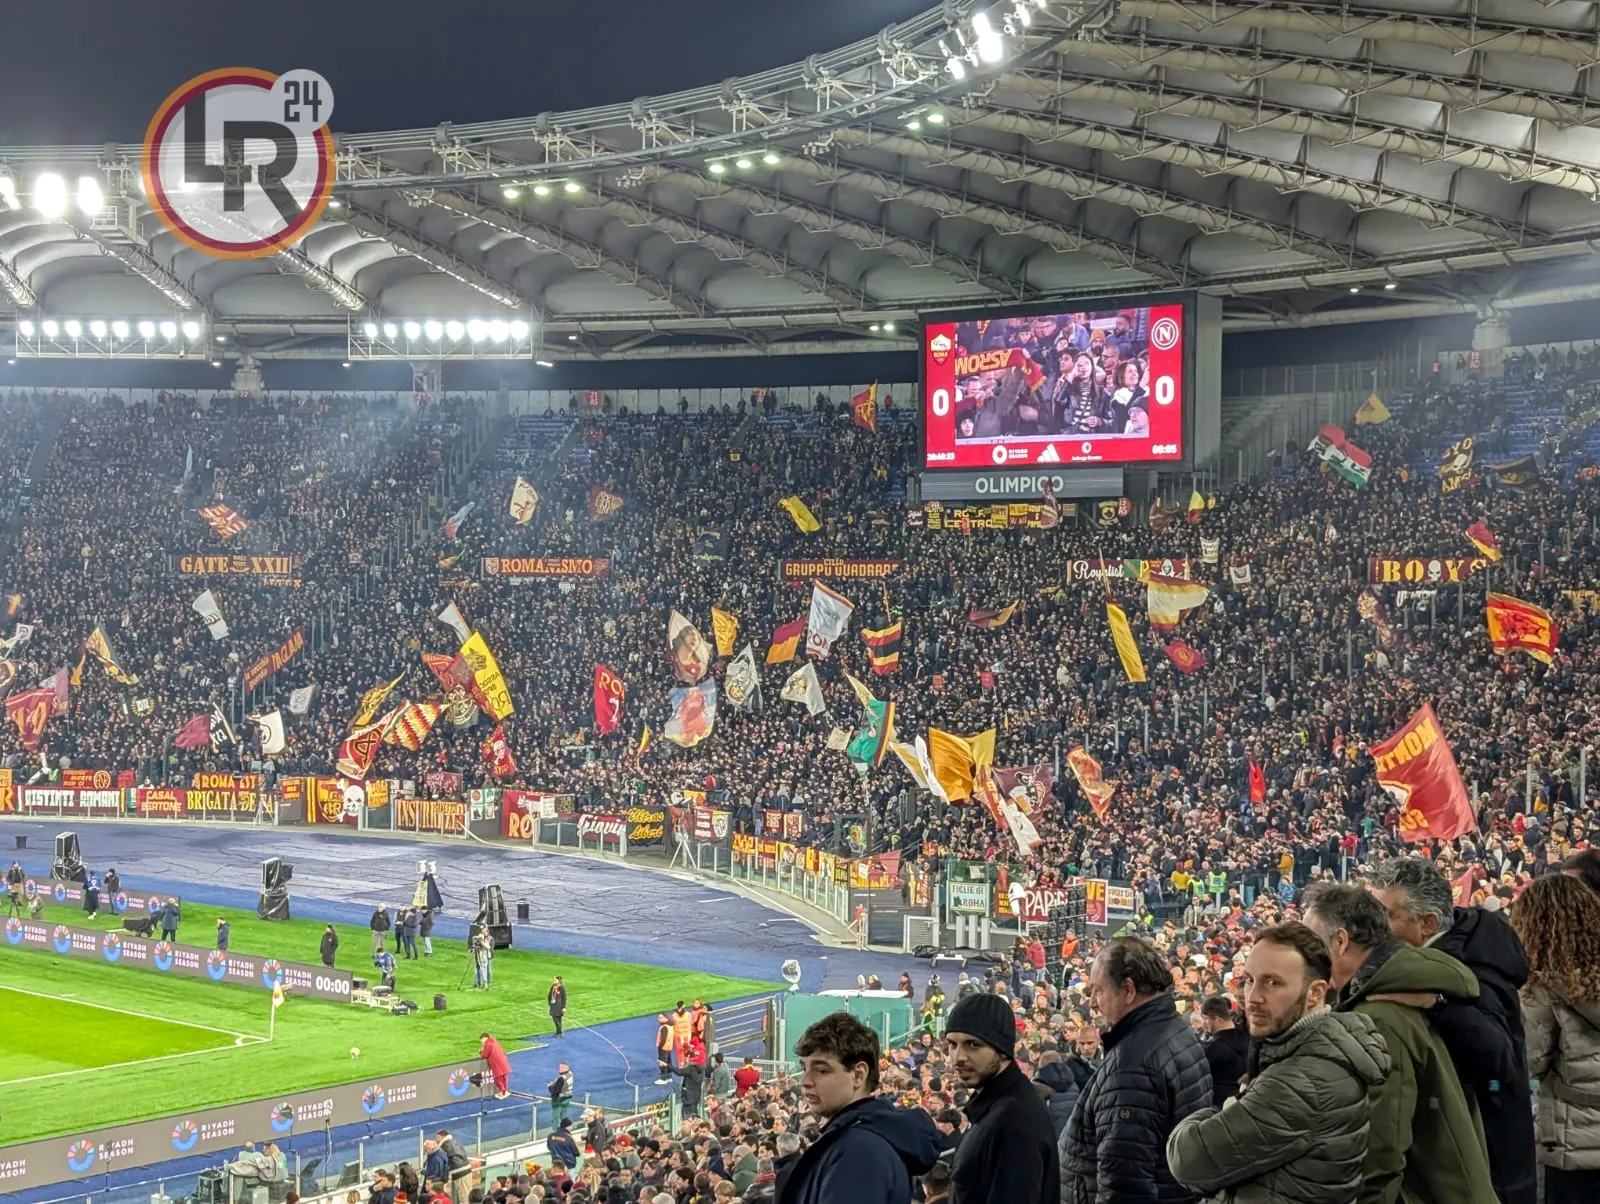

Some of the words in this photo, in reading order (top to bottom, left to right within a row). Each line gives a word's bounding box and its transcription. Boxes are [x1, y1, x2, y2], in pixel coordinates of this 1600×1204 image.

[1155, 375, 1174, 405] 0
[932, 388, 949, 416] 0
[975, 475, 1064, 494] OLIMPICO
[180, 556, 229, 573] GATE
[250, 556, 289, 574] XXII
[202, 774, 236, 788] ROMA
[25, 789, 75, 807] DISTINTI
[147, 790, 177, 801] CASAL
[187, 790, 238, 811] BRIGATA
[24, 925, 47, 935] RIYADH
[24, 932, 47, 943] SEASON
[73, 933, 96, 943] RIYADH
[73, 940, 96, 951] SEASON
[123, 941, 146, 951] RIYADH
[123, 948, 146, 960] SEASON
[174, 950, 199, 961] RIYADH
[174, 957, 199, 969] SEASON
[228, 959, 254, 970] RIYADH
[228, 967, 254, 978] SEASON
[285, 968, 312, 979] RIYADH
[285, 976, 312, 988] SEASON
[315, 976, 350, 995] 00:00
[388, 1084, 417, 1096] RIYADH
[388, 1092, 417, 1104] SEASON
[201, 1119, 235, 1132] RIYADH
[201, 1128, 235, 1140] SEASON
[98, 1138, 134, 1152] RYADH
[98, 1147, 134, 1160] SEASON
